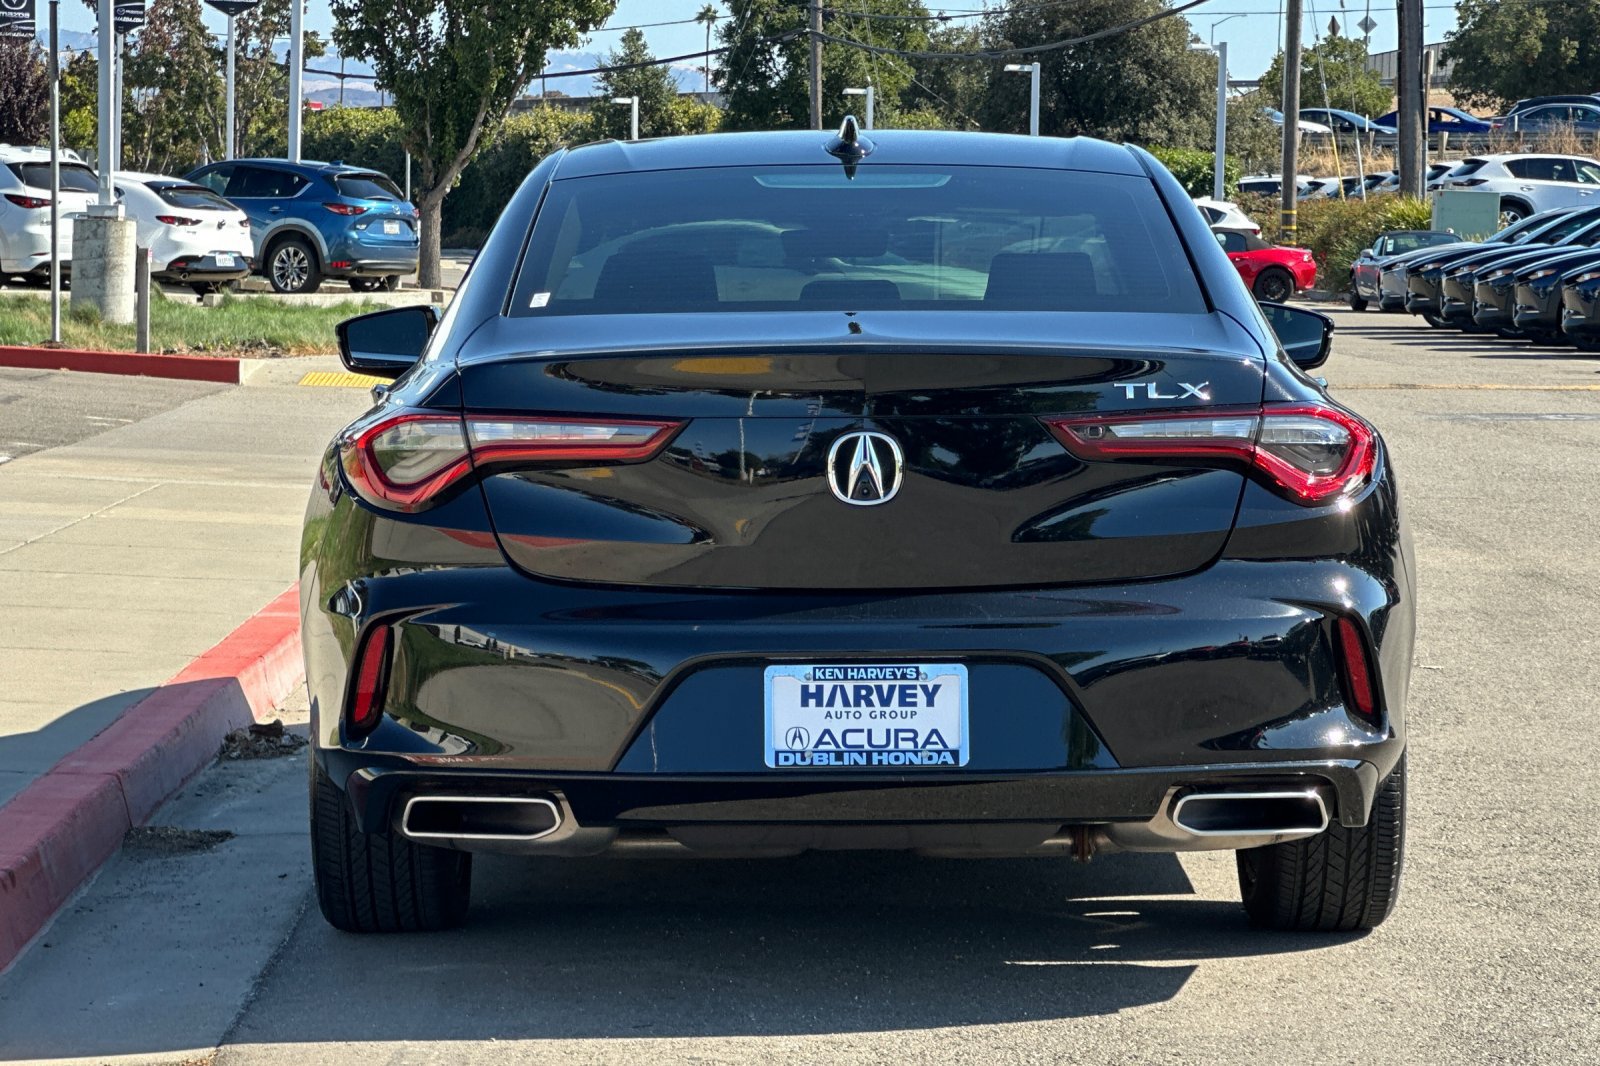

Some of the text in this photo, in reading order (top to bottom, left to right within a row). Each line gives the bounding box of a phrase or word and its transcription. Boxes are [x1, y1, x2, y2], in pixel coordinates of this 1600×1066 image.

[1113, 381, 1211, 399] TLX
[815, 668, 917, 680] KEN HARVEY'S
[800, 684, 942, 708] HARVEY
[824, 710, 918, 720] AUTO GROUP
[812, 728, 949, 749] ACURA
[778, 752, 955, 766] DUBLIN HONDA
